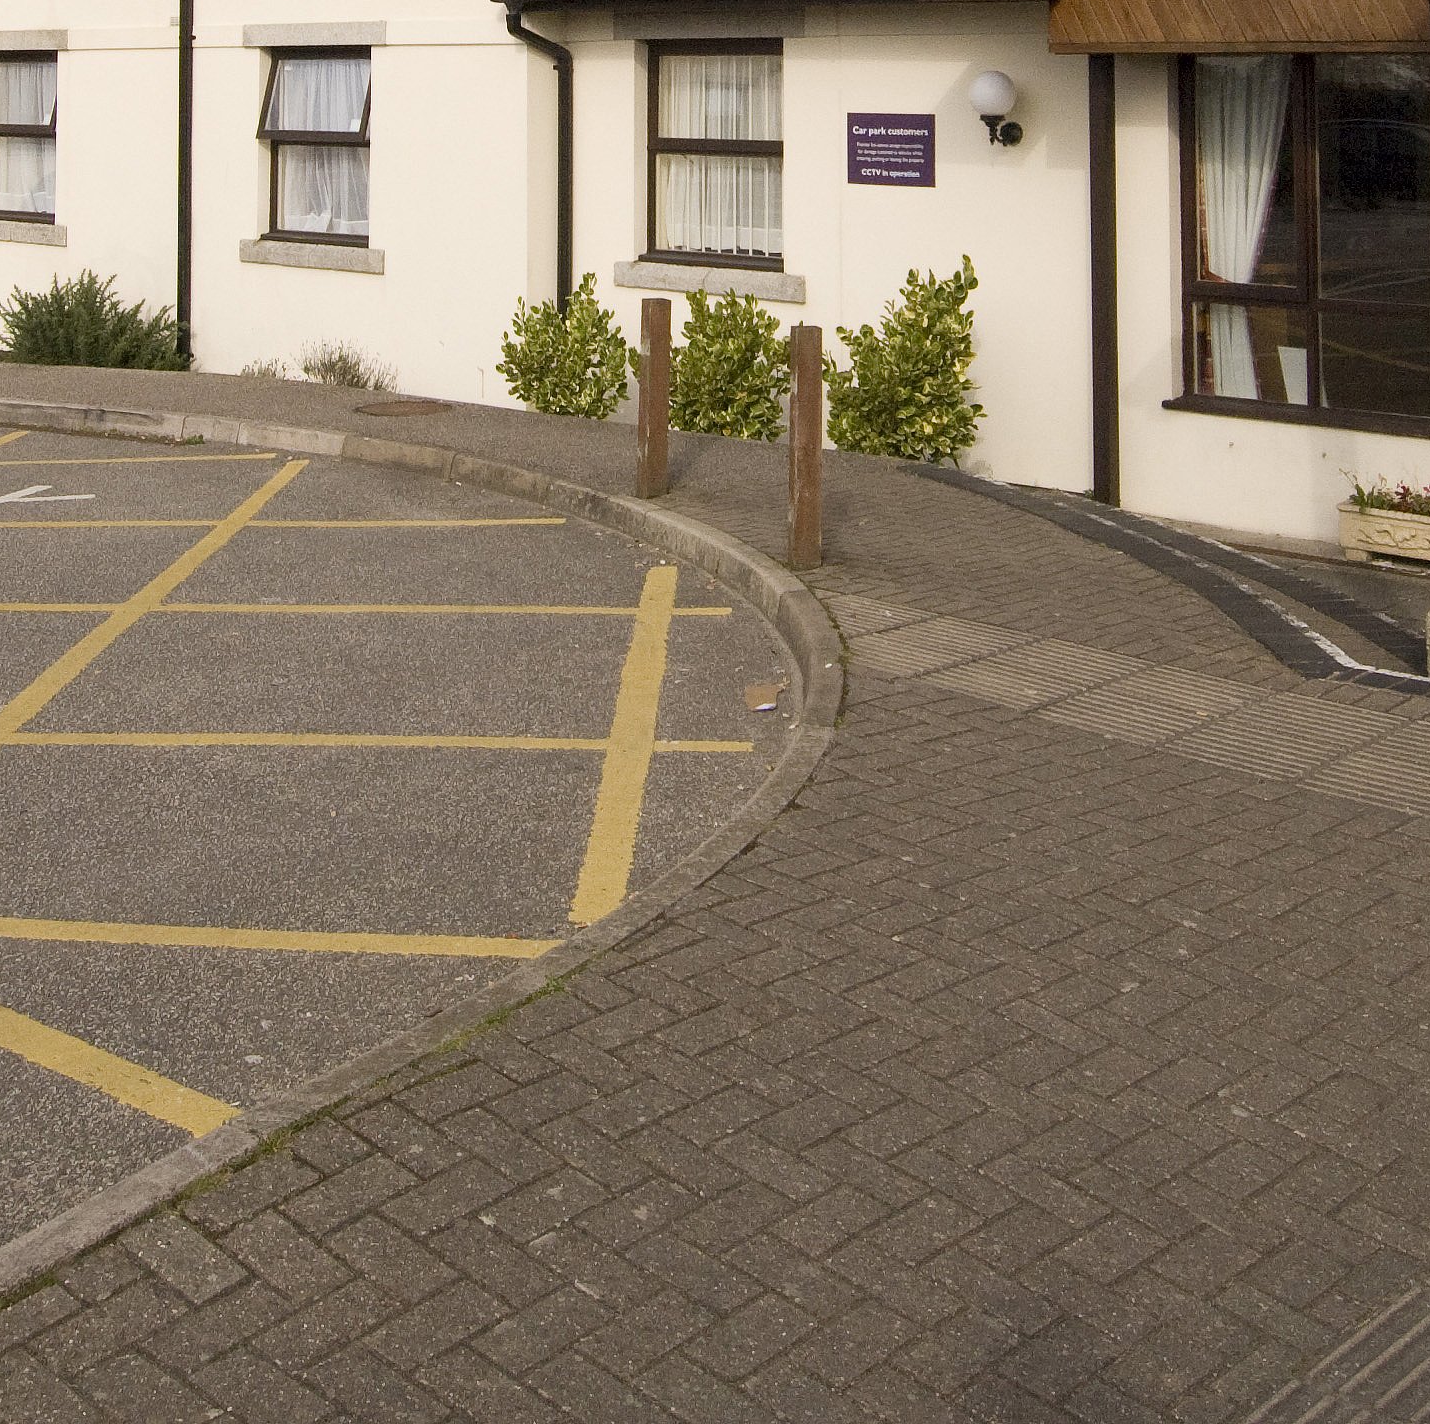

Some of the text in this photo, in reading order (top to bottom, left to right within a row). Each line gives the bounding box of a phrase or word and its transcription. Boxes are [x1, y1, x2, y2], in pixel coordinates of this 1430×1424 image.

[852, 125, 929, 137] Car park customers
[861, 168, 881, 176] CCTV
